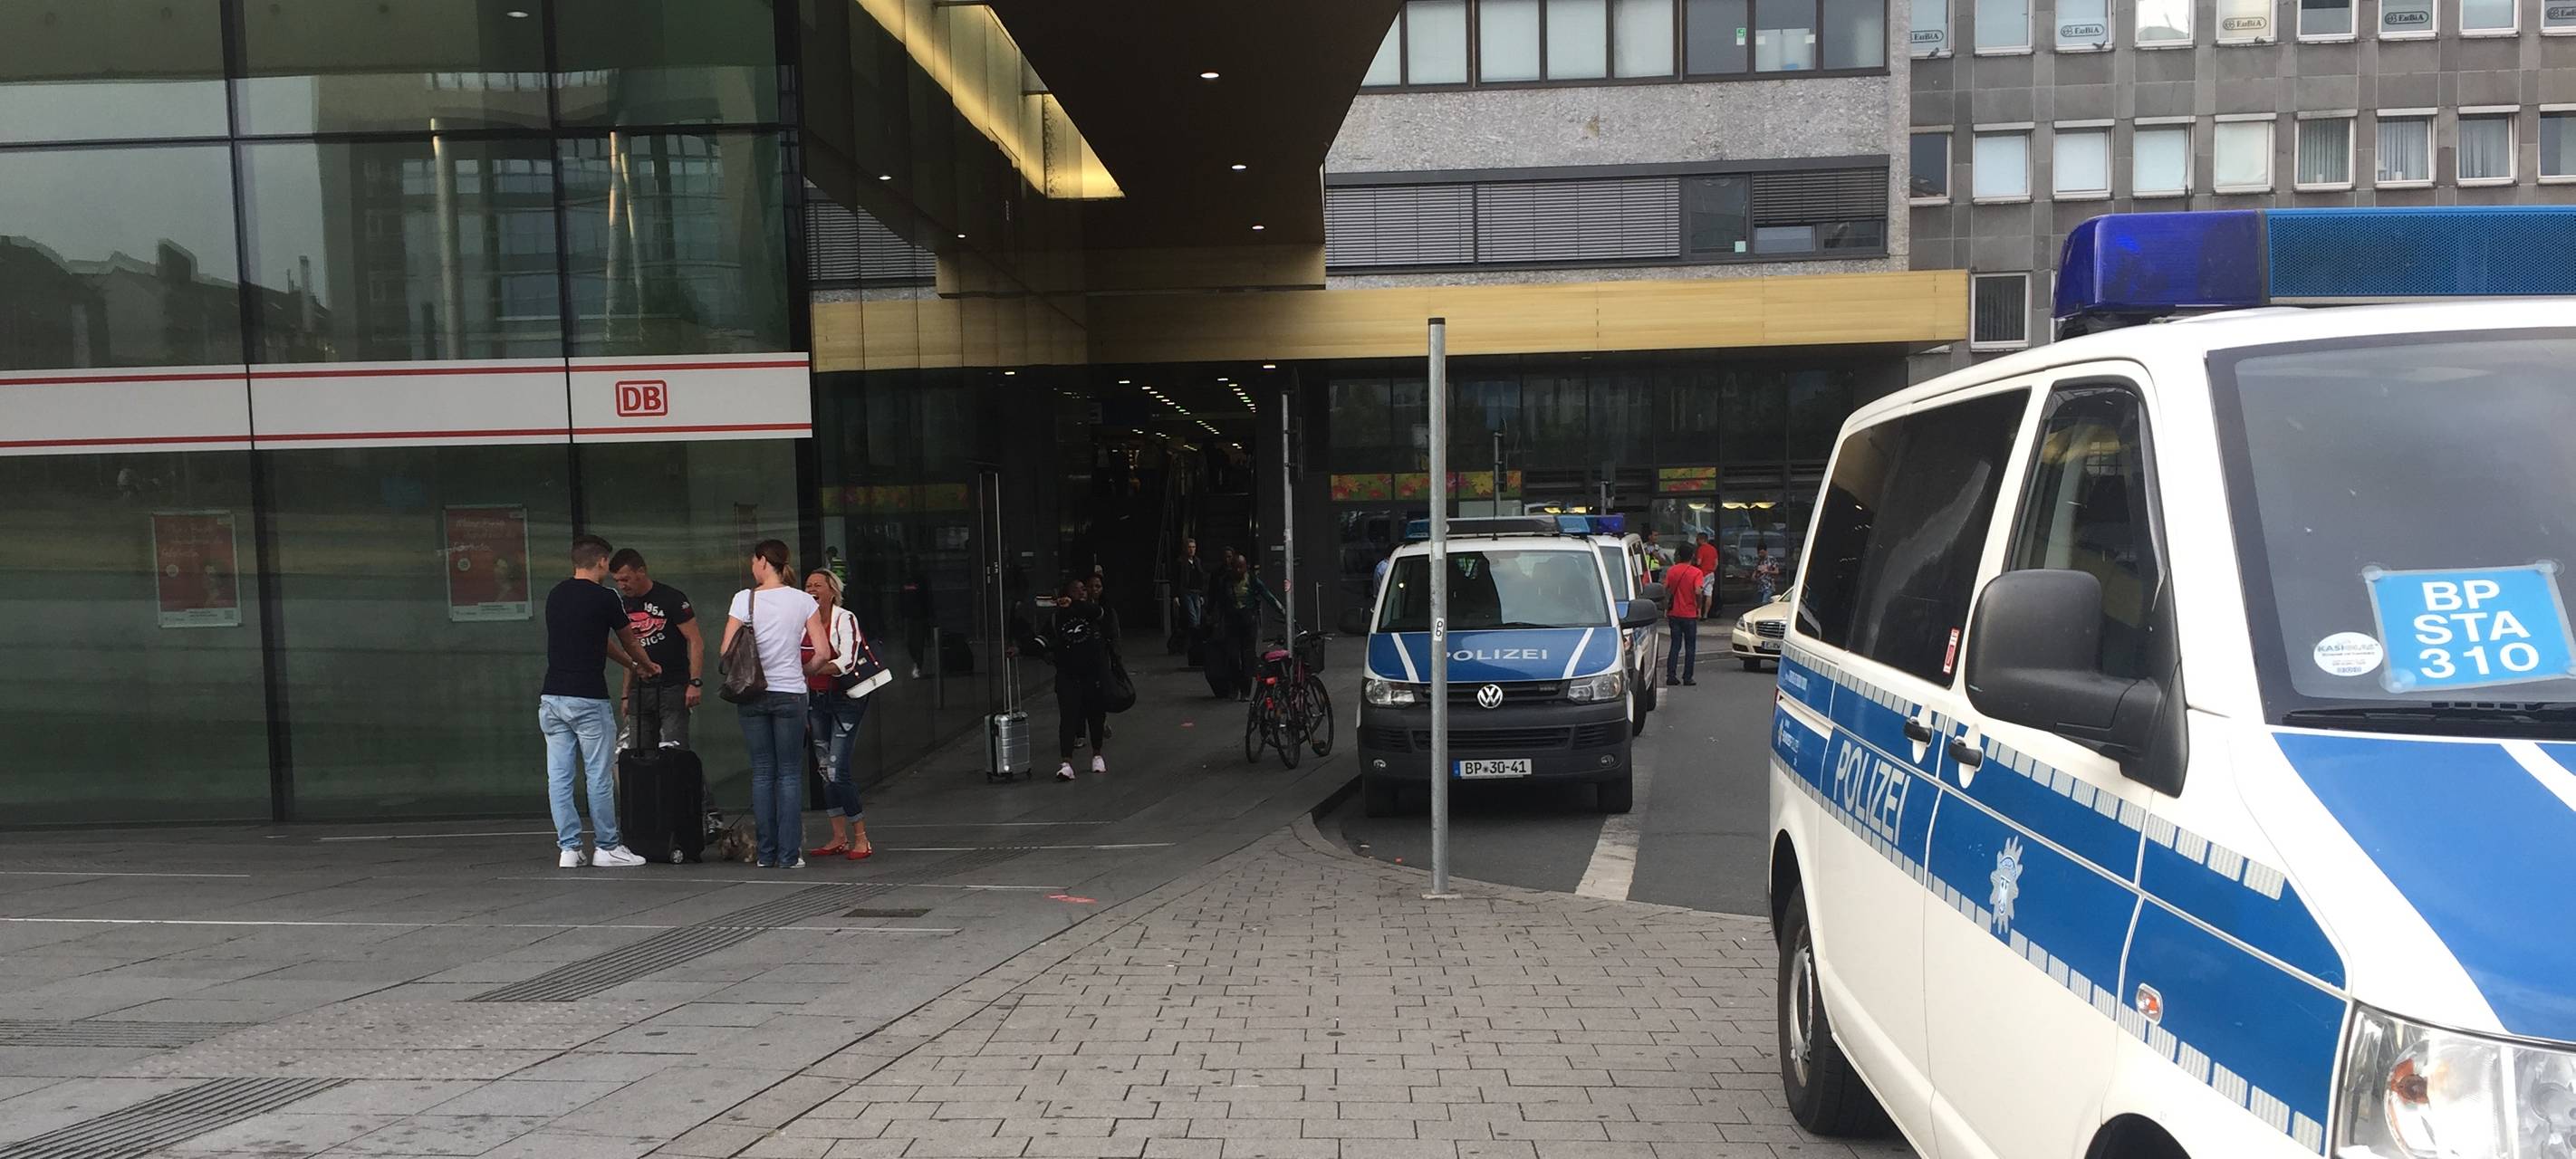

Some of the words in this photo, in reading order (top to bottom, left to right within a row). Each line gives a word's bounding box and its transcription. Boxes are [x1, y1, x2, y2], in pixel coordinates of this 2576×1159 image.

[621, 386, 662, 411] DB
[644, 602, 665, 617] 1954
[2421, 580, 2501, 611] BP
[2414, 610, 2531, 645] STA
[1447, 648, 1548, 661] OLIZEI
[2419, 642, 2540, 678] 310
[1833, 740, 1911, 847] POLIZEI
